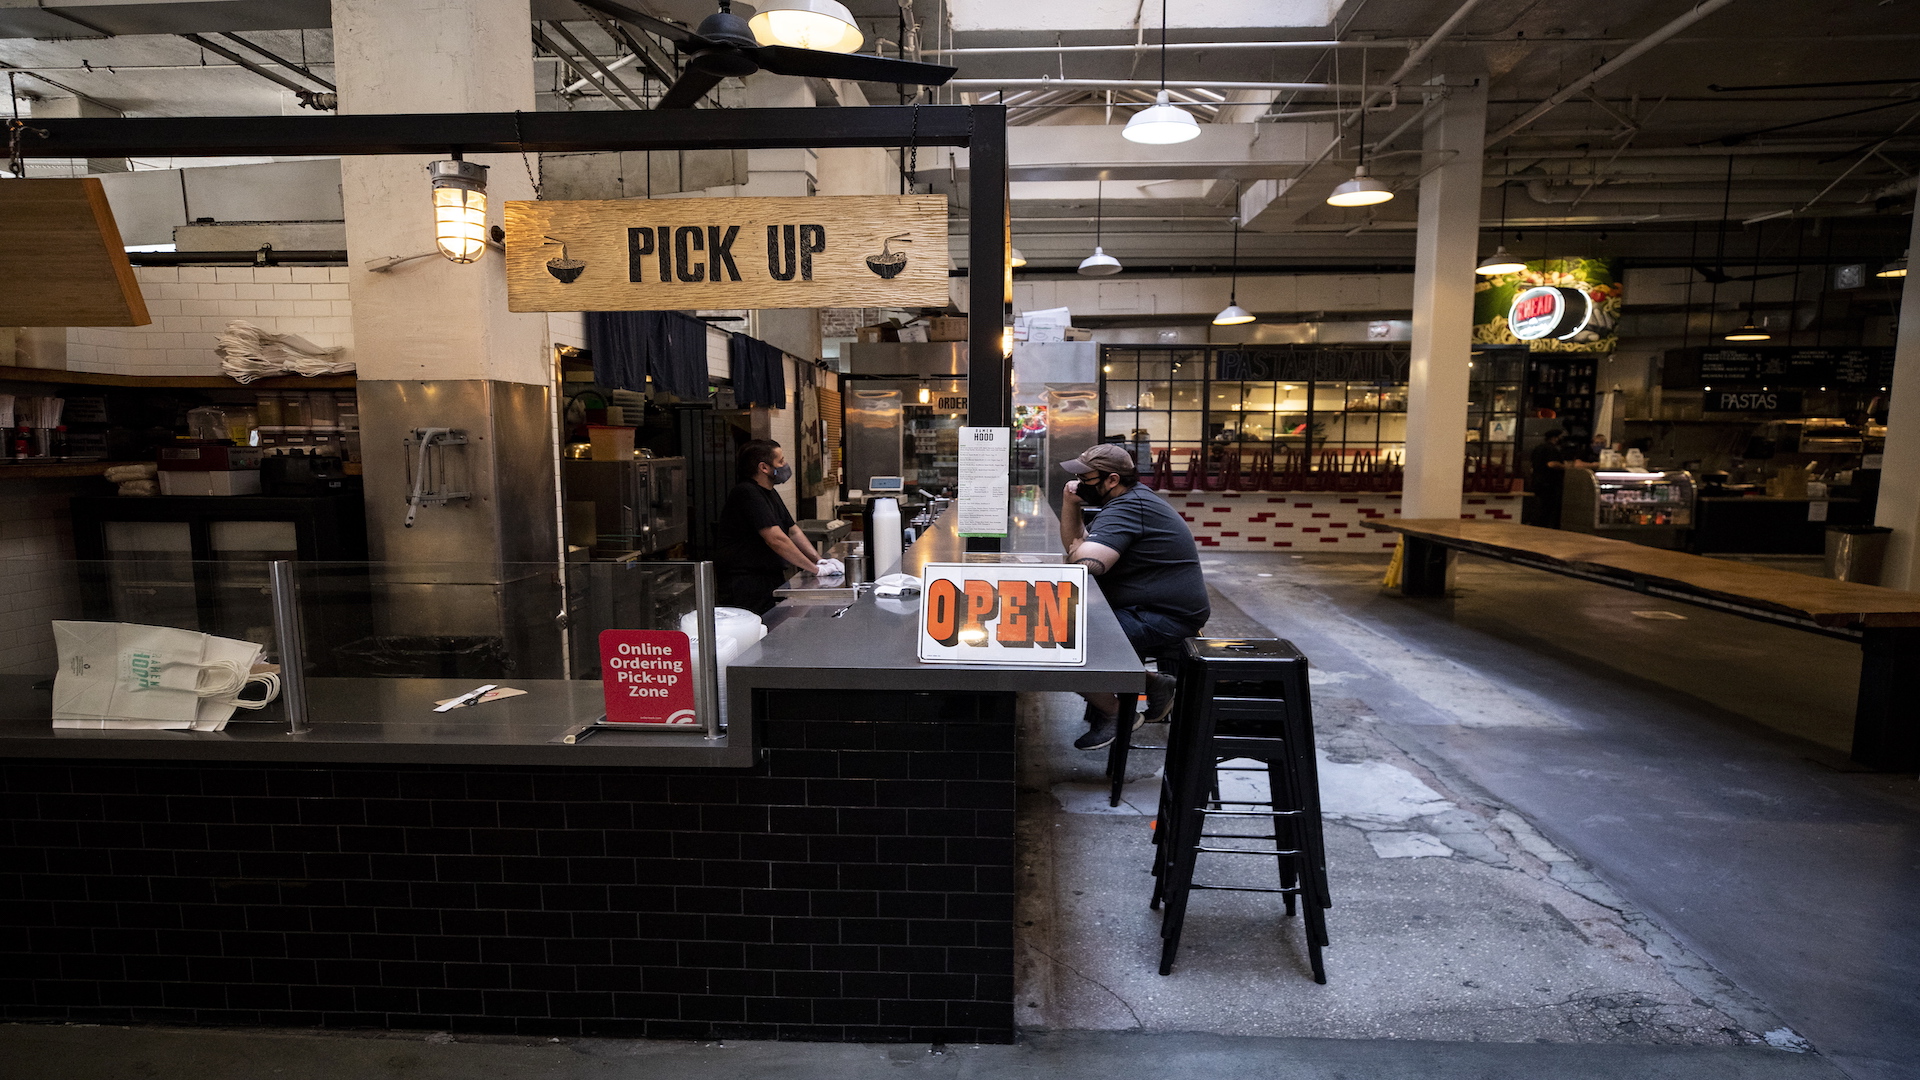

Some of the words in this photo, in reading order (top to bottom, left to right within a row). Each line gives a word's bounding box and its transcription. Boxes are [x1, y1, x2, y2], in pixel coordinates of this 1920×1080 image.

[627, 225, 742, 283] PICK
[767, 224, 826, 281] UP
[1222, 351, 1298, 380] PASTA
[1336, 351, 1411, 380] DAILY
[938, 397, 968, 409] ORDER
[1720, 393, 1778, 409] PASTAS
[1494, 422, 1504, 432] A
[974, 433, 994, 441] HOOD
[927, 578, 1079, 649] OPEN
[618, 643, 672, 655] Online
[610, 657, 683, 673] Ordering
[617, 671, 678, 686] Pick-up
[628, 685, 669, 697] Zone
